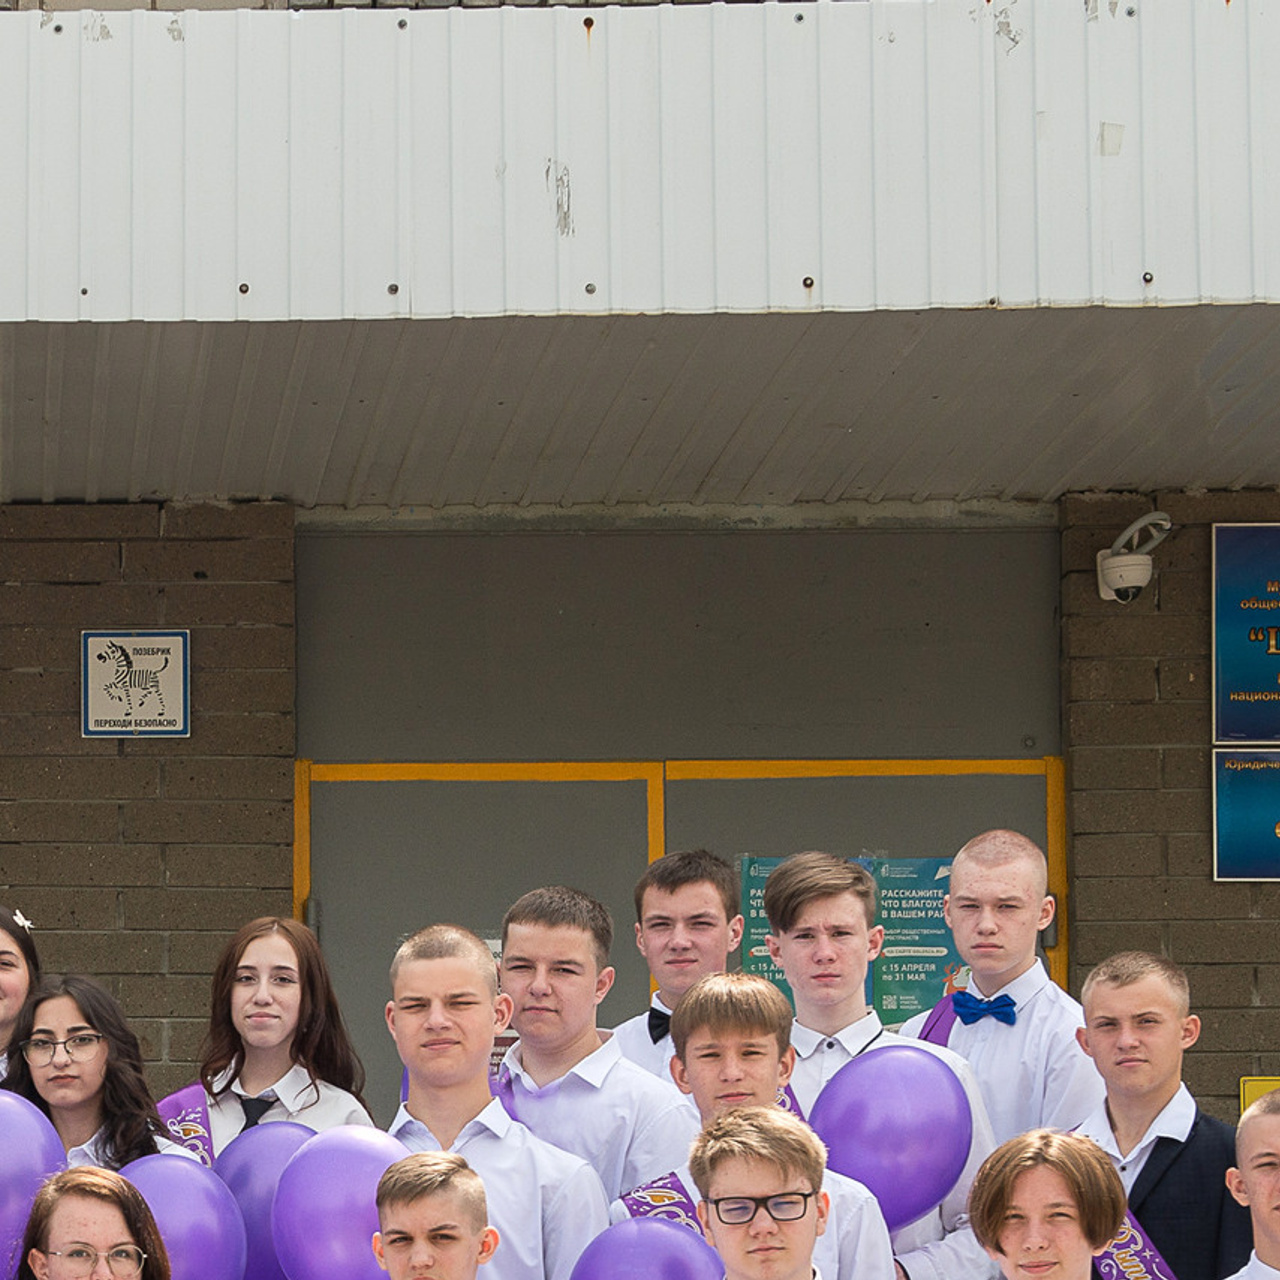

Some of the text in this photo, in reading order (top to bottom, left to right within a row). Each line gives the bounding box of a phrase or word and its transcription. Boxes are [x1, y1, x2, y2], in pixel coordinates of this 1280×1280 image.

[94, 719, 177, 728] ПЕРЕХОДИ БЕЗОПАСНО
[881, 900, 899, 908] ЧТО
[881, 910, 888, 918] В
[890, 910, 925, 918] ВАШЕМ
[901, 963, 936, 971] АПРЕЛЯ
